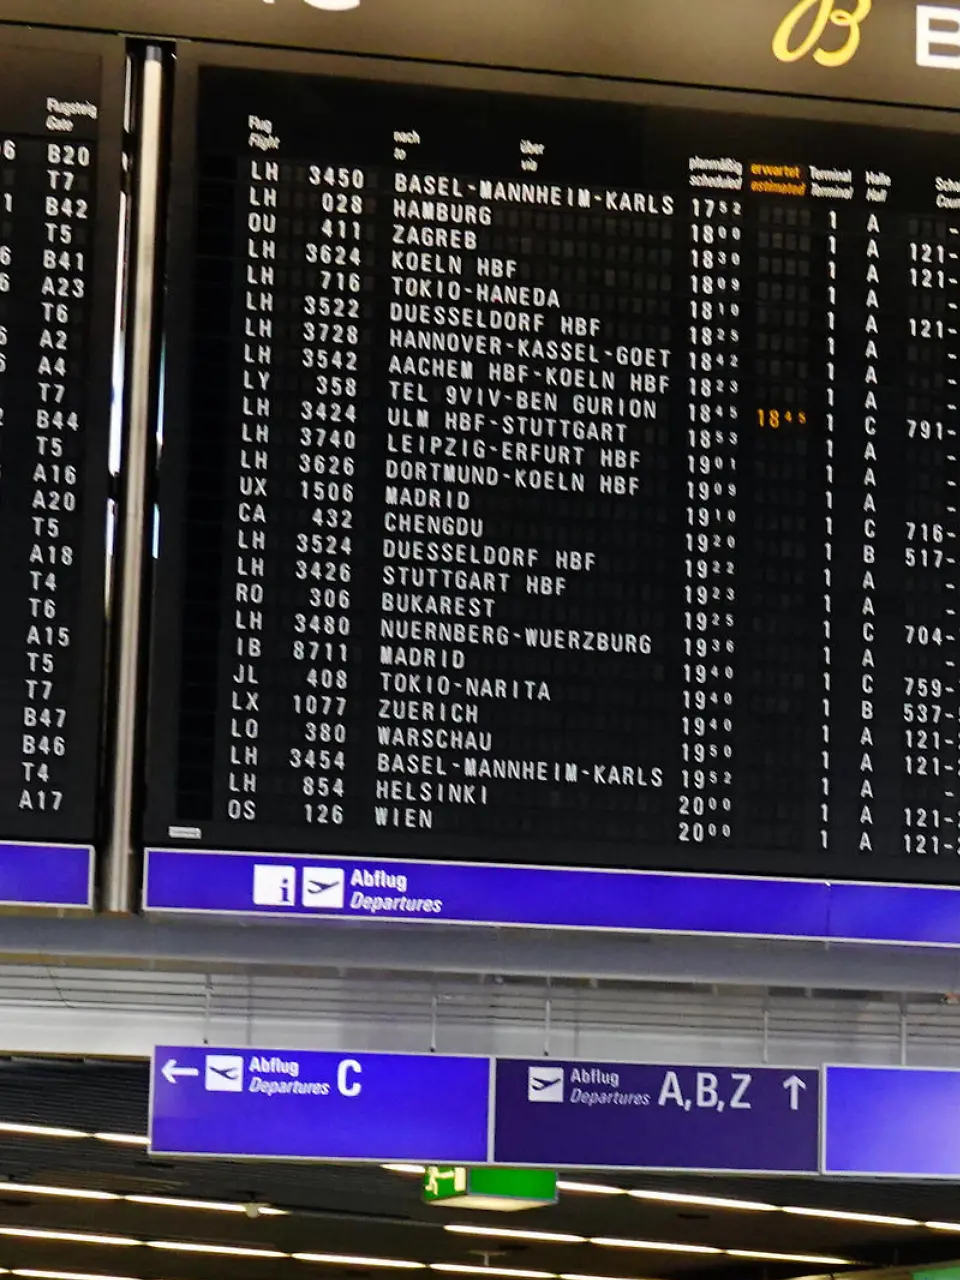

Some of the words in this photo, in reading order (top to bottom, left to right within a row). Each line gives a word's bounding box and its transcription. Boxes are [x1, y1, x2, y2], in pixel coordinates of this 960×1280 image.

[47, 143, 90, 167] B20
[45, 196, 88, 219] B42
[308, 165, 364, 189] 3450
[394, 172, 674, 215] BASEL-MANNHEIM-KARLS
[322, 192, 363, 215] 028
[393, 198, 492, 226] HAMBURG
[248, 212, 276, 234] OU
[321, 219, 360, 241] 411
[392, 224, 477, 250] ZAGREB
[305, 243, 361, 266] 3624
[391, 250, 462, 275] KOELN
[477, 257, 517, 279] HBF
[41, 276, 85, 298] A23
[321, 270, 360, 292] 716
[391, 276, 560, 308] TOKIO-HANEDA
[304, 295, 359, 318] 3522
[390, 302, 545, 332] DUESSELDORF
[561, 315, 600, 337] HBF
[303, 322, 358, 345] 3728
[389, 328, 671, 368] HANNOVER-KASSEL-GOET
[302, 348, 357, 371] 3542
[489, 362, 615, 390] HBF-KOELN
[630, 373, 670, 394] HBF
[316, 375, 357, 397] 358
[389, 380, 428, 403] TEL
[573, 394, 656, 419] GURION
[300, 400, 357, 423] 3424
[387, 407, 429, 428] ULM
[445, 411, 627, 443] HBF-STUTTGART
[300, 427, 356, 449] 3740
[387, 433, 584, 465] LEIPZIG-ERFURT
[600, 448, 640, 469] HBF
[298, 453, 354, 476] 3626
[385, 459, 584, 492] DORTMUND-KOELN
[599, 474, 639, 496] HBF
[32, 489, 75, 511] A20
[239, 476, 267, 497] UX
[301, 480, 354, 503] 1506
[385, 485, 470, 510] MADRID
[238, 502, 266, 523] CA
[312, 508, 353, 529] 432
[384, 512, 483, 538] CHENGDU
[296, 533, 352, 556] 3524
[383, 539, 538, 567] DUESSELDORF
[555, 550, 596, 571] HBF
[295, 560, 351, 583] 3426
[382, 565, 510, 592] STUTTGART
[526, 574, 566, 596] HBF
[236, 582, 264, 604] RO
[309, 587, 350, 609] 306
[381, 592, 495, 618] BUKAREST
[294, 613, 350, 636] 3480
[381, 619, 652, 654] NUERNBERG-WUERZBURG
[293, 640, 347, 662] 8711
[380, 645, 465, 669] MADRID
[306, 668, 347, 689] 408
[380, 671, 551, 702] TOKIO-NARITA
[23, 706, 67, 728] B47
[293, 694, 347, 716] 1077
[378, 699, 478, 724] ZUERICH
[304, 722, 346, 743] 380
[377, 726, 492, 751] WARSCHAU
[289, 748, 345, 770] 3454
[377, 753, 663, 787] BASEL-MANNHEIM-KARLS
[303, 776, 344, 798] 854
[376, 779, 487, 805] HELSINKI
[305, 803, 343, 825] 126
[374, 806, 432, 829] WIEN
[351, 868, 407, 892] Abflug
[350, 891, 442, 913] Departures
[249, 1056, 299, 1077] Abflug
[337, 1059, 362, 1096] C
[570, 1068, 619, 1087] Abflug
[249, 1077, 330, 1096] Departures
[570, 1088, 650, 1106] Departures
[658, 1071, 751, 1112] A,B,Z
